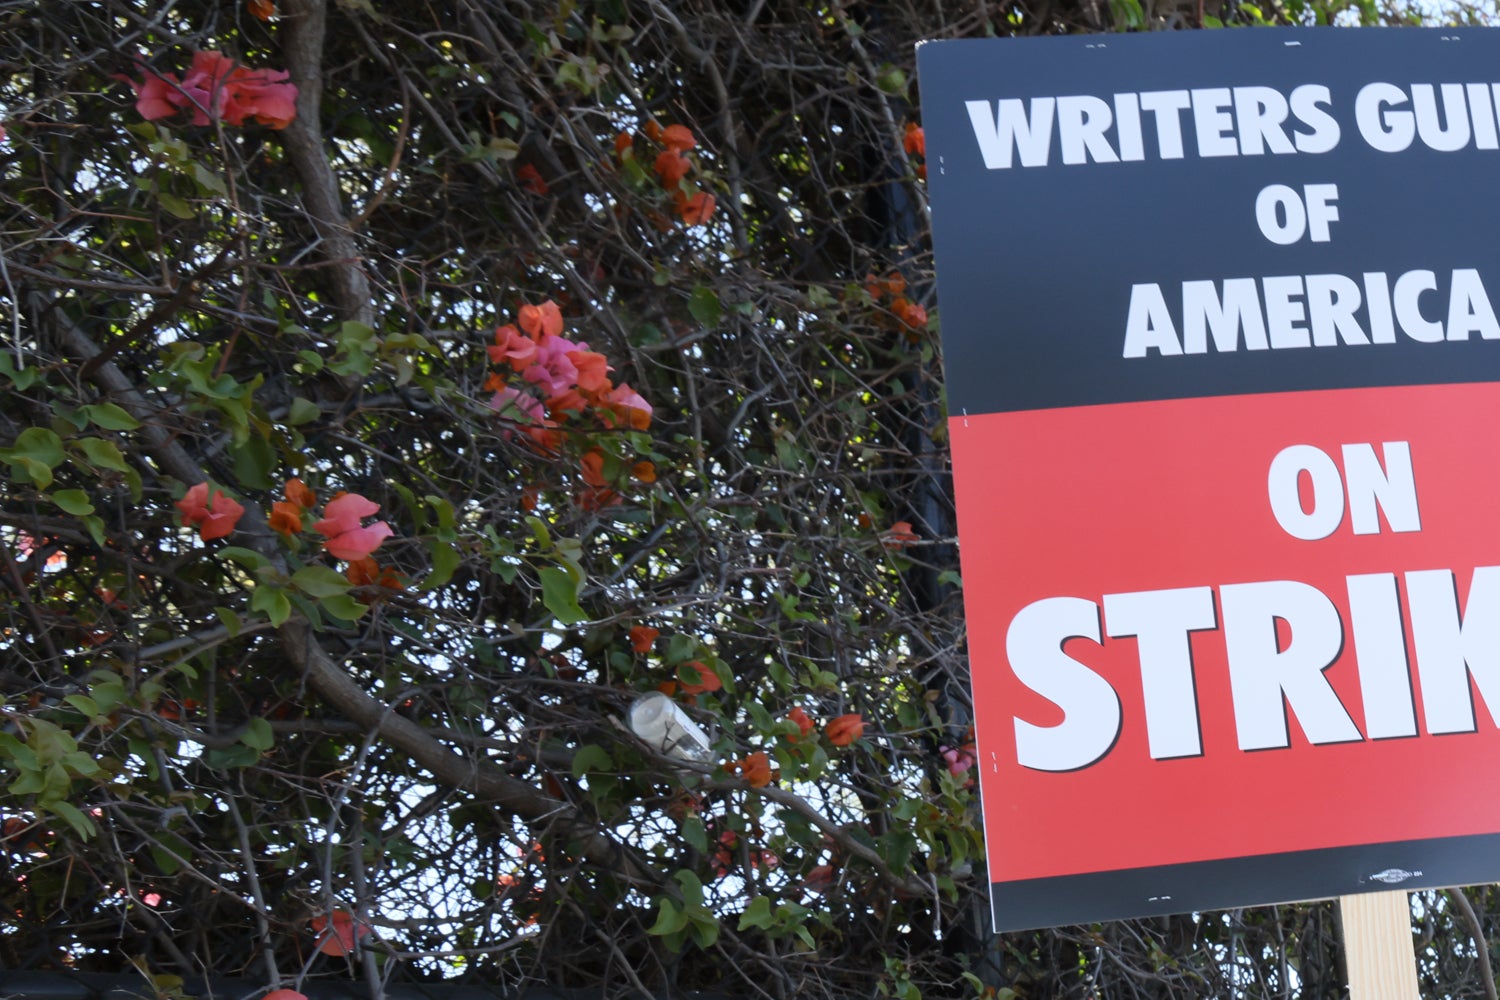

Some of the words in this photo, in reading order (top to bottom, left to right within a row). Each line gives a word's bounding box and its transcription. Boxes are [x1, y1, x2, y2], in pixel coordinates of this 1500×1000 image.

[965, 84, 1341, 170] WRITERS
[1255, 184, 1340, 245] OF
[1268, 440, 1422, 541] ON
